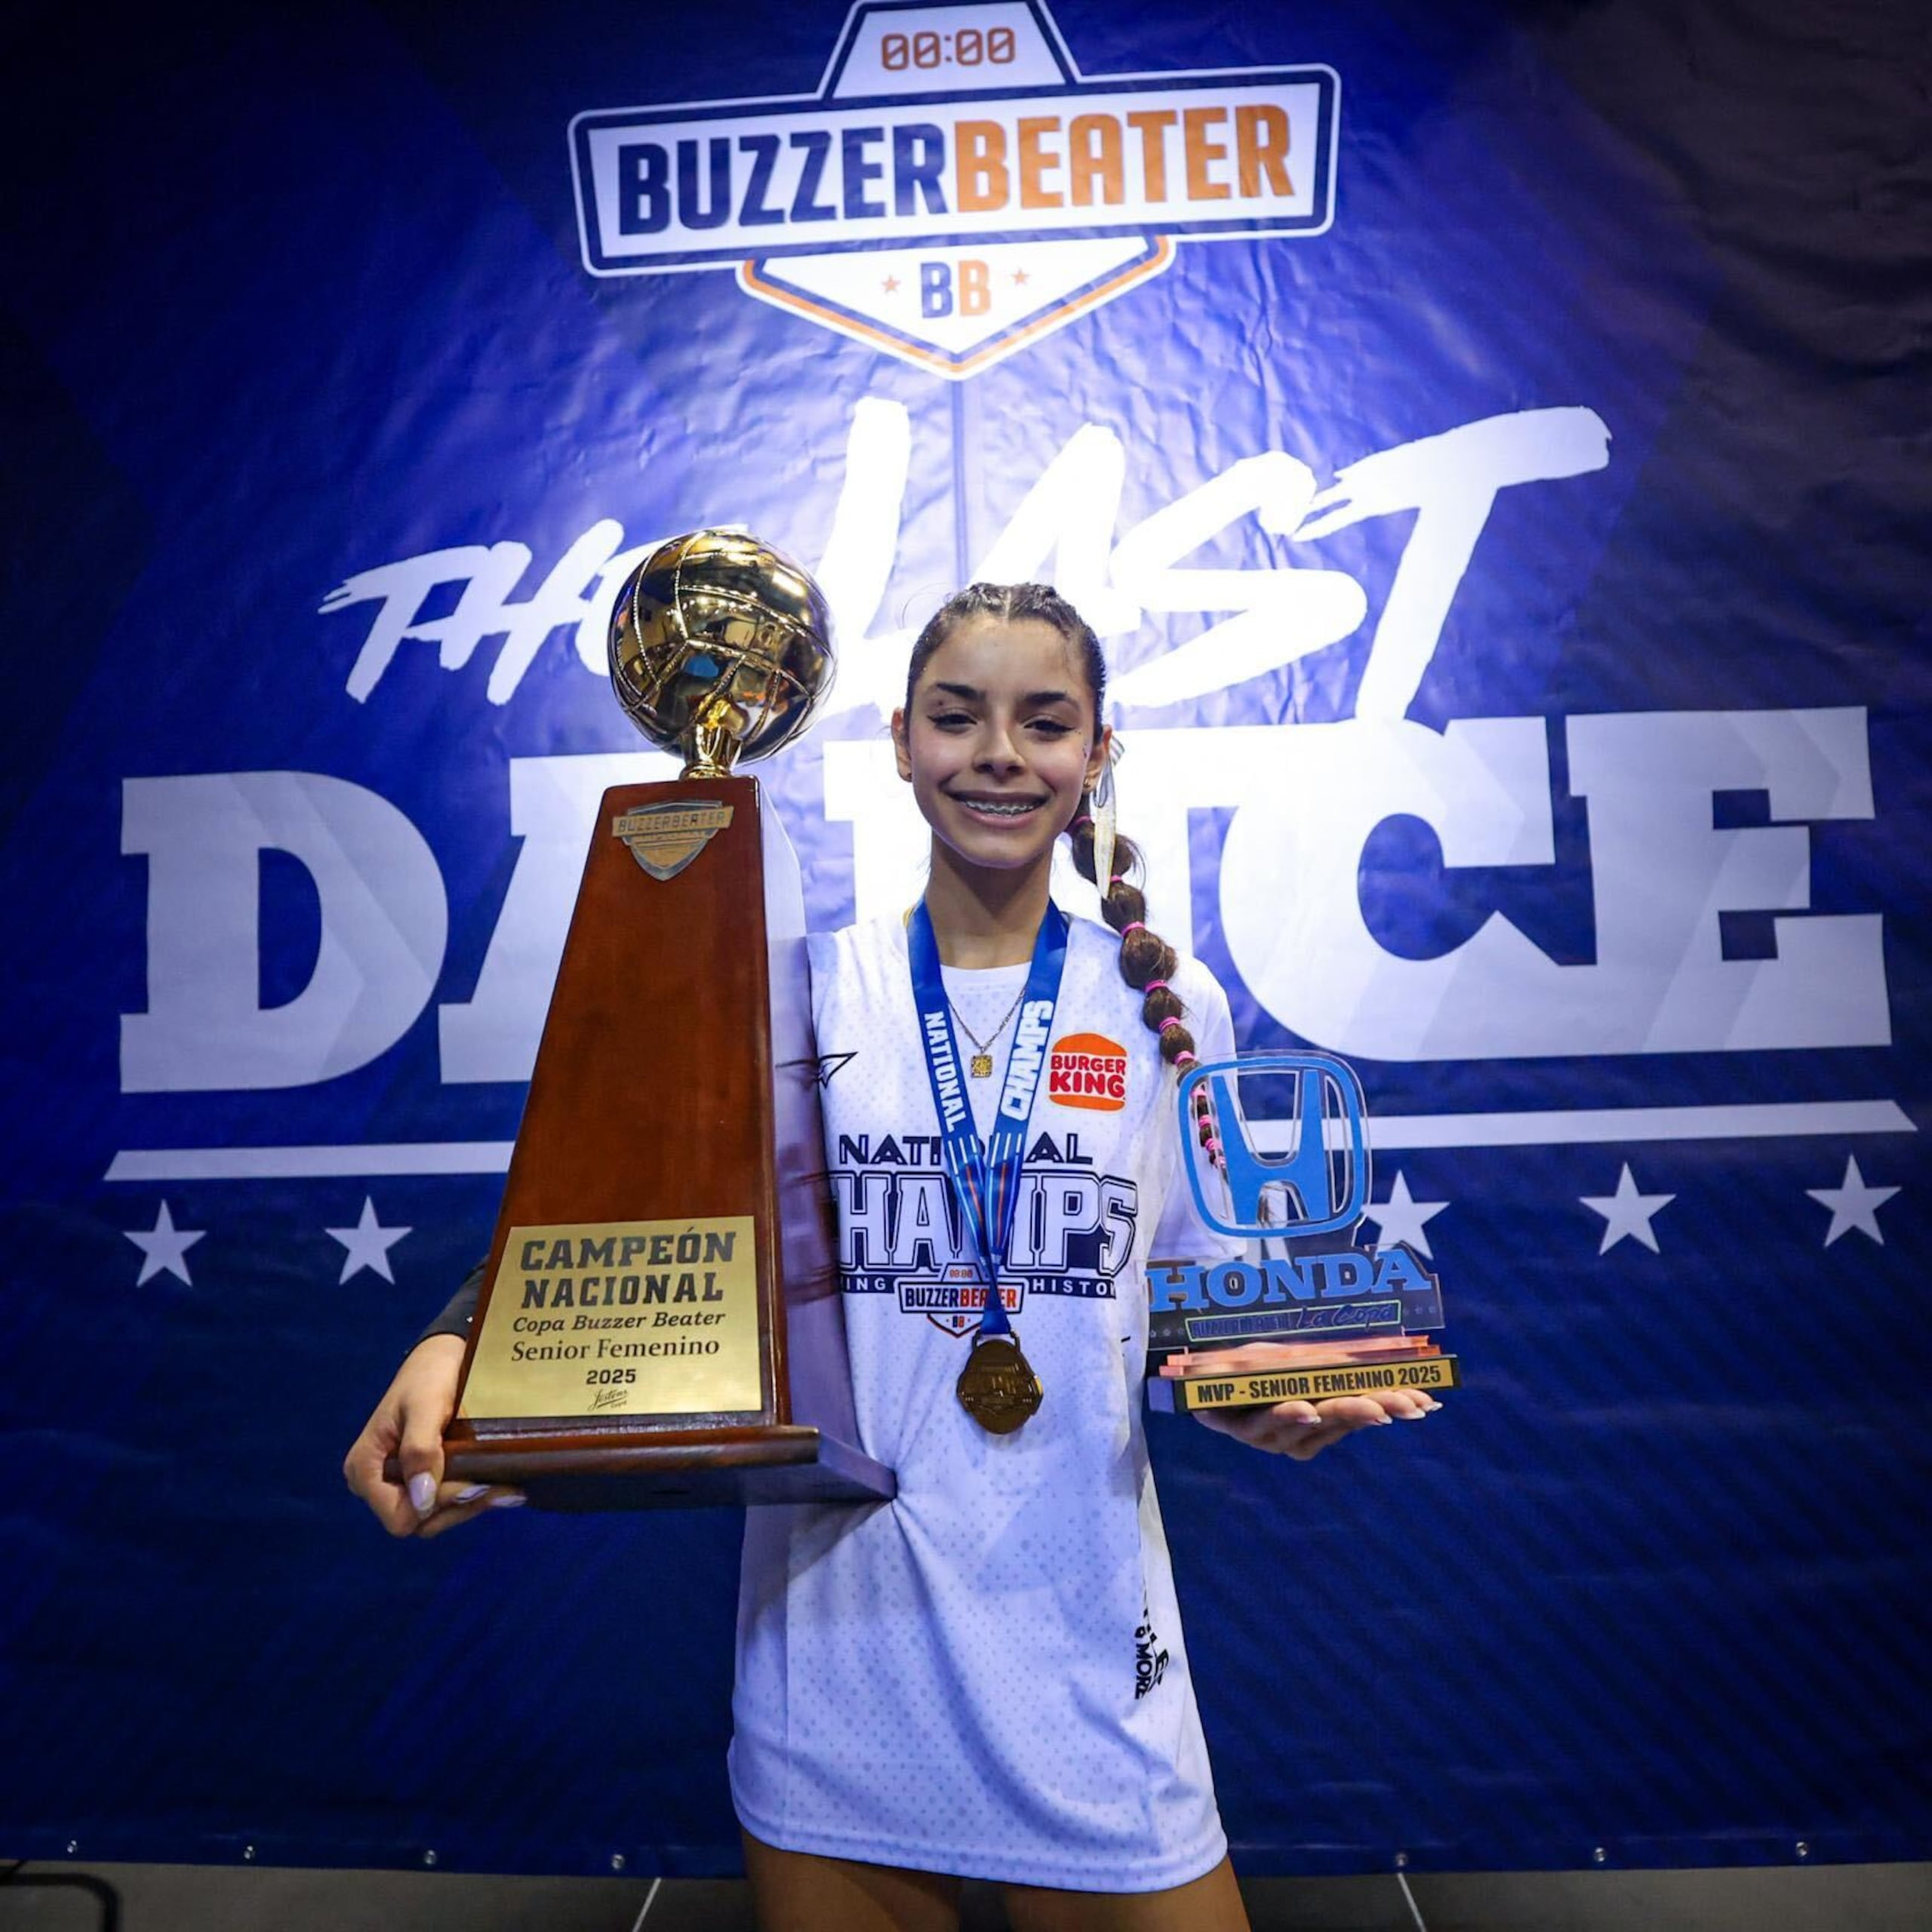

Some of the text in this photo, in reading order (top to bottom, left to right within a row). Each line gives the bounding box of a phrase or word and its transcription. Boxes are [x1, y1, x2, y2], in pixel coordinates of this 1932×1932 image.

[881, 26, 1017, 72] 00:00
[617, 103, 1296, 238] BUZZERBEATER
[920, 260, 993, 320] BB
[924, 1011, 966, 1133] NATIONAL
[1000, 1000, 1054, 1122] CHAMPS
[1050, 1054, 1126, 1075] BURGER
[1049, 1070, 1125, 1099] KING
[839, 1131, 1093, 1166] NATIAL
[521, 1226, 737, 1271] CAMPEÓN
[521, 1272, 723, 1309] NACIONAL
[906, 1287, 1017, 1308] BUZZERBEAER
[1144, 1248, 1432, 1312] HONDA
[513, 1312, 726, 1336] Copa Buzzer Beater
[1296, 1306, 1325, 1329] La
[512, 1336, 720, 1361] Senior Femenino
[586, 1369, 636, 1384] 2025
[1198, 1383, 1235, 1403] MVP
[1249, 1377, 1309, 1398] SENIOR
[1314, 1369, 1395, 1393] FEMENINO
[1397, 1365, 1442, 1385] 2025
